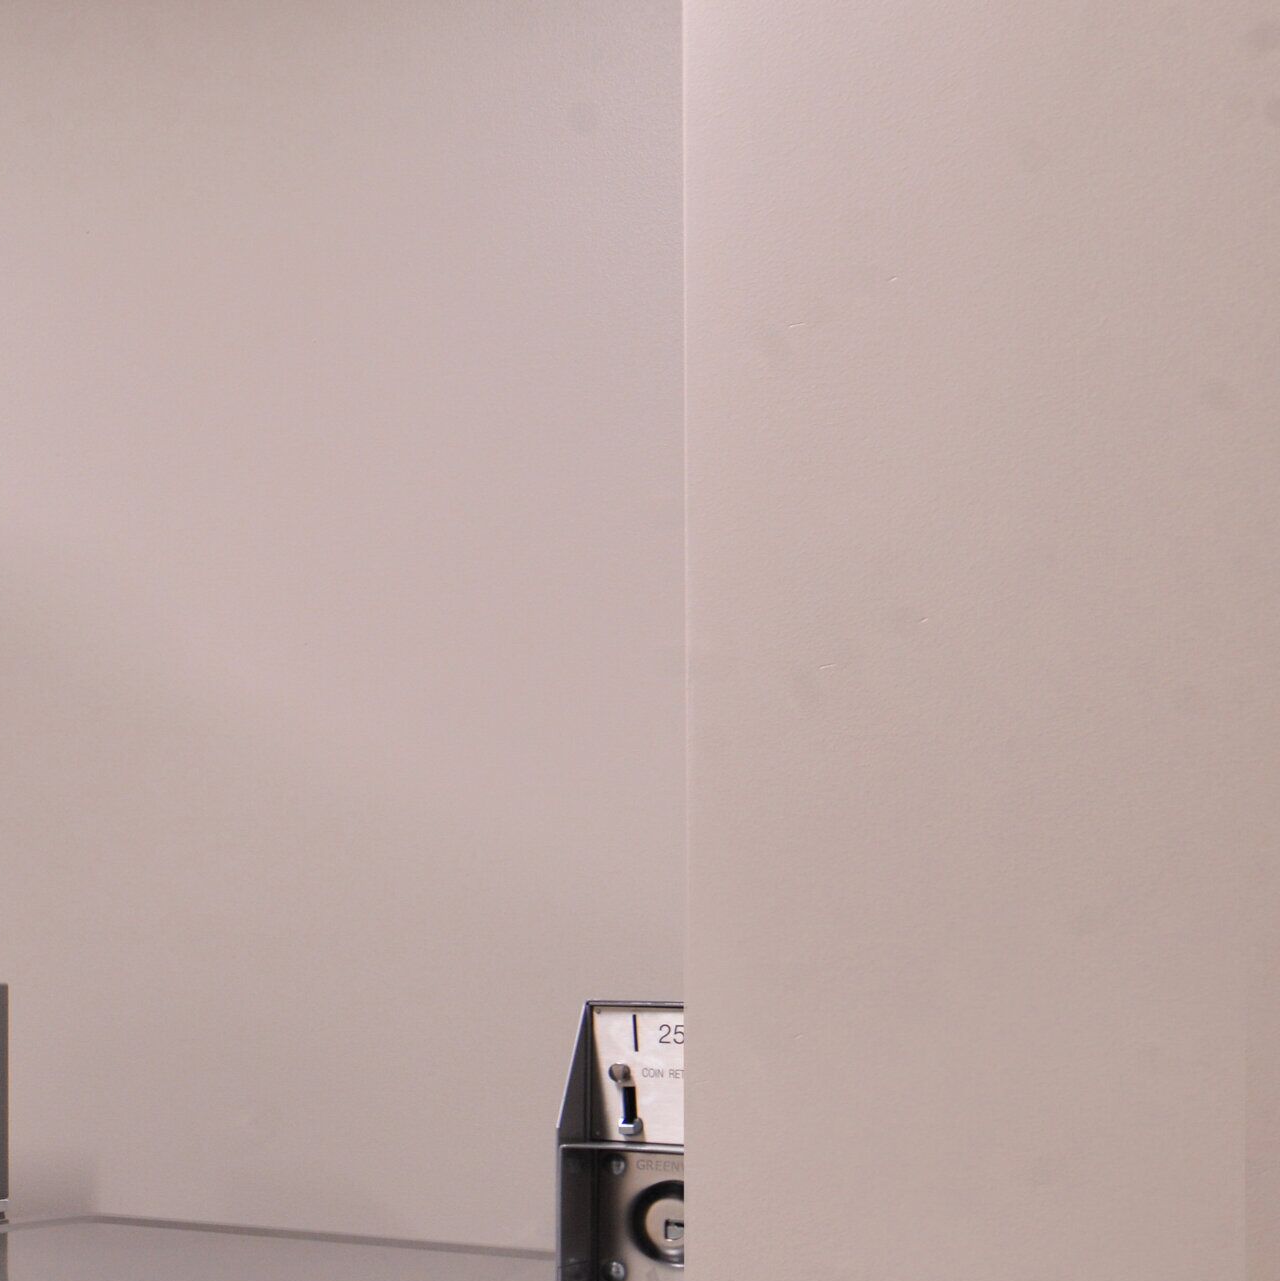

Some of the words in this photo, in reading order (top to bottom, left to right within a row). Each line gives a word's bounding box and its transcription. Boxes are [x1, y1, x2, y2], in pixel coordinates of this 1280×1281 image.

[642, 1067, 664, 1078] COIN
[669, 1069, 684, 1079] RET
[636, 1159, 684, 1172] GREEN
